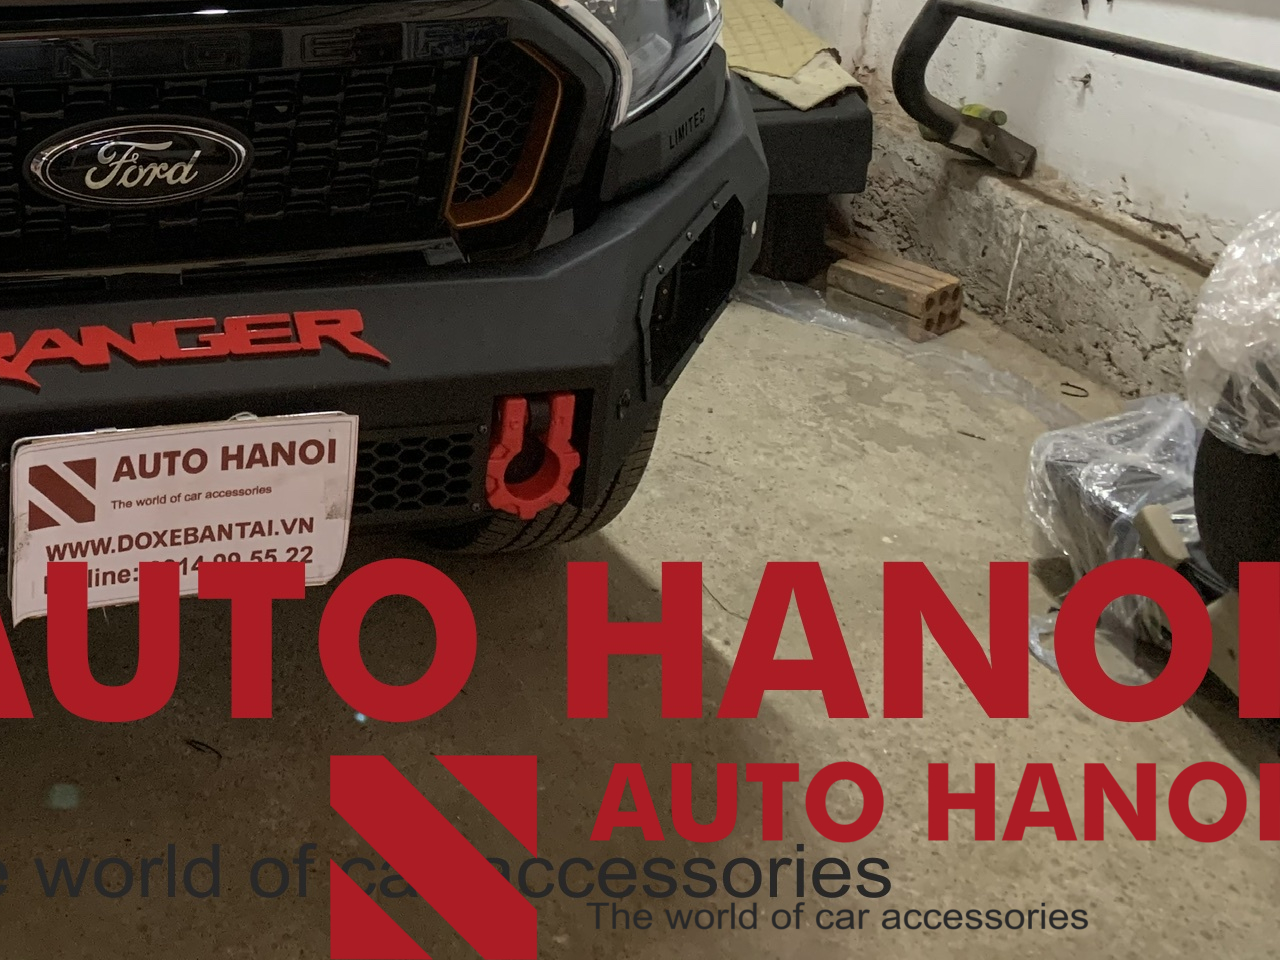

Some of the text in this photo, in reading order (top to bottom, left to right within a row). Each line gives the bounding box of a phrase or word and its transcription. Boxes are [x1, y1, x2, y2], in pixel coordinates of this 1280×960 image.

[668, 107, 707, 150] LIMITED
[84, 139, 202, 190] Ford
[112, 438, 337, 483] AUTO HANOI
[111, 485, 273, 510] The world of car accessories
[45, 516, 314, 563] WWW.DOXEBANTAI.VN
[43, 567, 139, 596] line:
